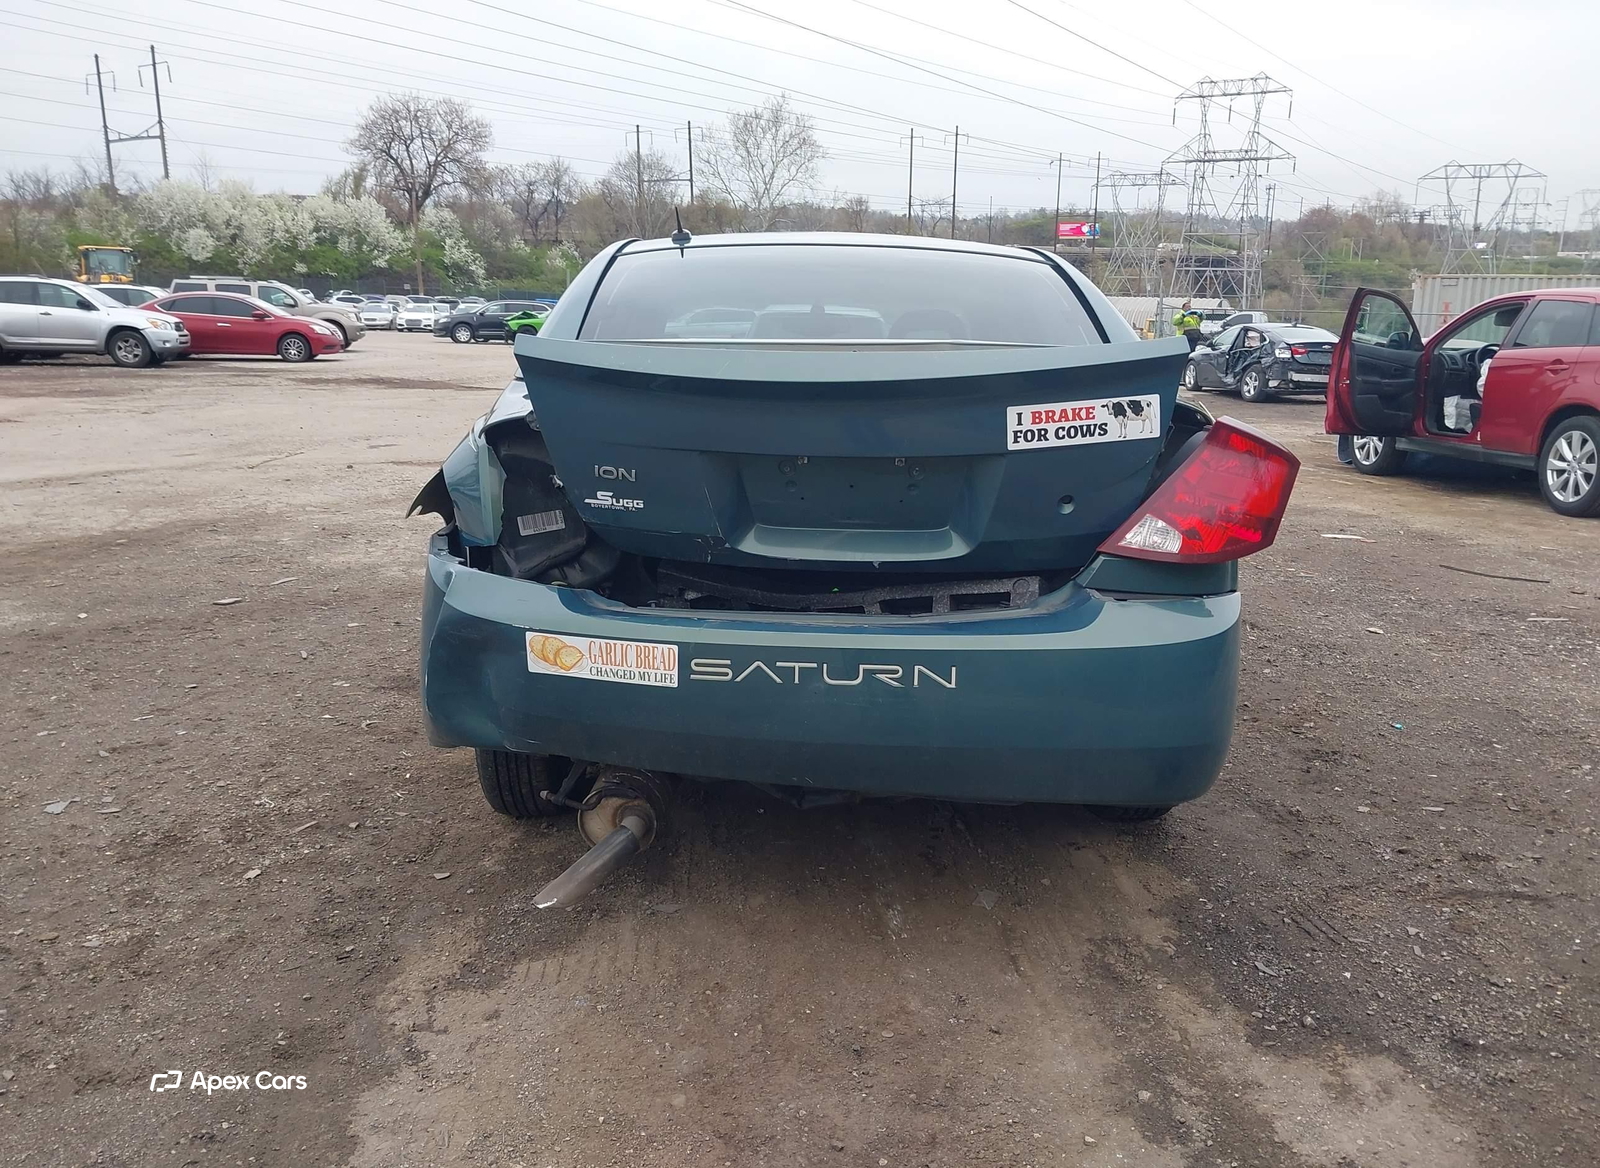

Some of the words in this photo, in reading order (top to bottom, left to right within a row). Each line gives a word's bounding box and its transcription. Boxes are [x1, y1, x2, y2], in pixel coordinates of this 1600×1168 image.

[1016, 412, 1023, 426] I
[1030, 406, 1096, 425] BRAKE
[1012, 428, 1049, 444] FOR
[1054, 422, 1108, 440] COWS
[588, 640, 633, 668] GARLIC
[635, 643, 677, 672] BREAD
[589, 665, 636, 681] CHANGED
[637, 671, 652, 682] MY
[654, 673, 676, 685] LIFE
[689, 658, 957, 688] SATURN
